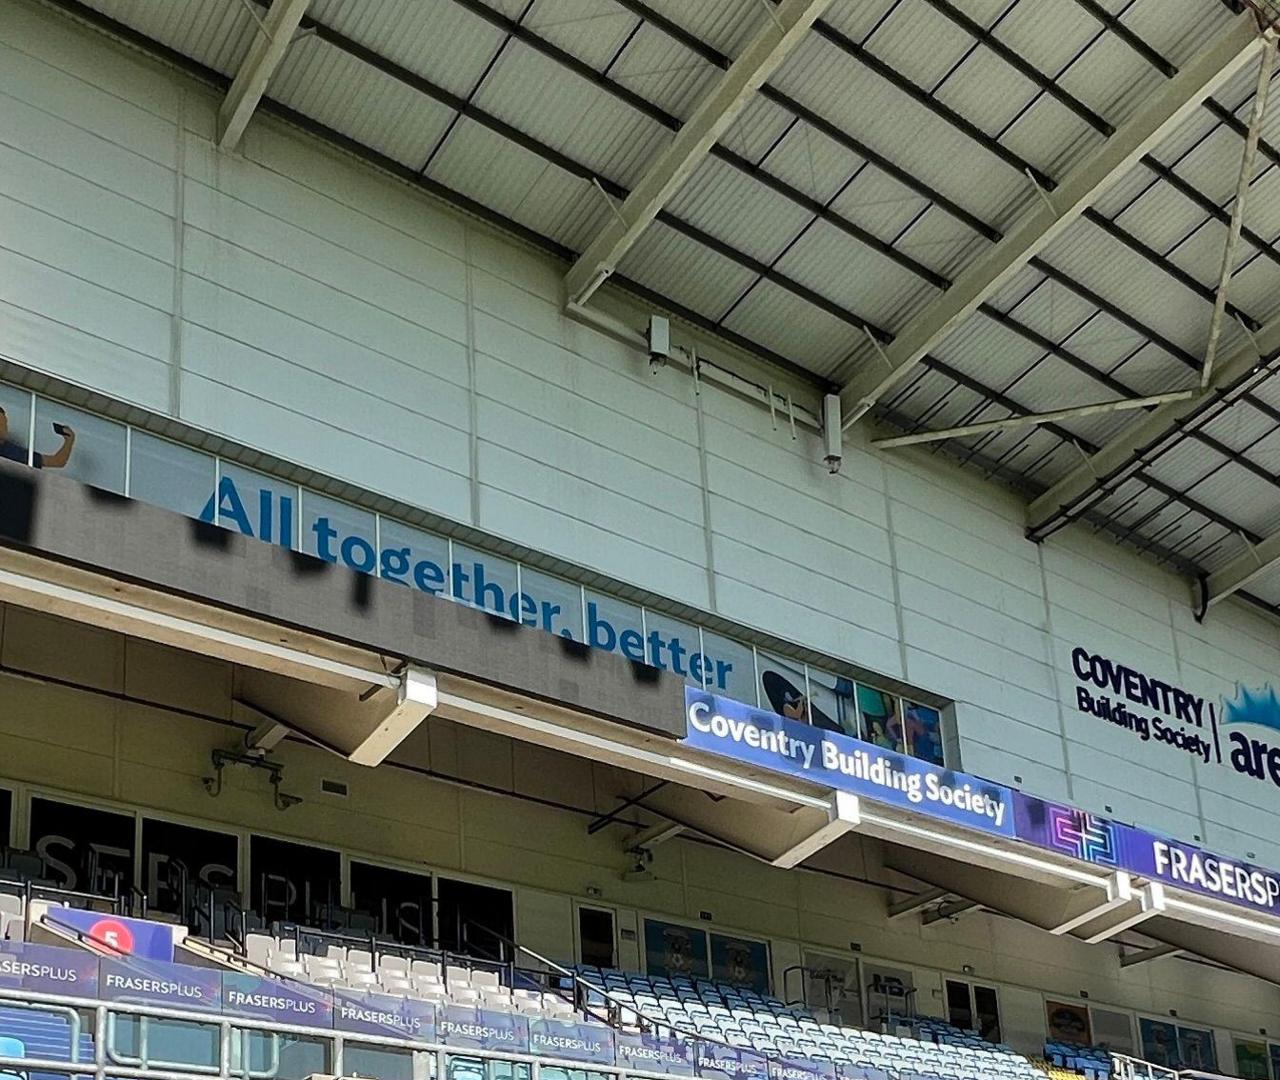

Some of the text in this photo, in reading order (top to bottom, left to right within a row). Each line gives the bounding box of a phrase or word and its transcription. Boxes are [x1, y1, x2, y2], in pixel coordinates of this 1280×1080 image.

[199, 476, 292, 551] All
[587, 602, 734, 690] better
[1072, 647, 1204, 727] COVENTRY
[1076, 686, 1211, 764] Building Society
[688, 702, 1005, 826] Coventry Building Society
[106, 975, 203, 999] FRASERSPLUS
[228, 990, 316, 1015] FRASERSPLUS
[341, 1006, 421, 1029] FRASERSPLUS
[440, 1021, 514, 1041] FRASERSPLUS
[533, 1033, 601, 1053] FRASERSPLUS
